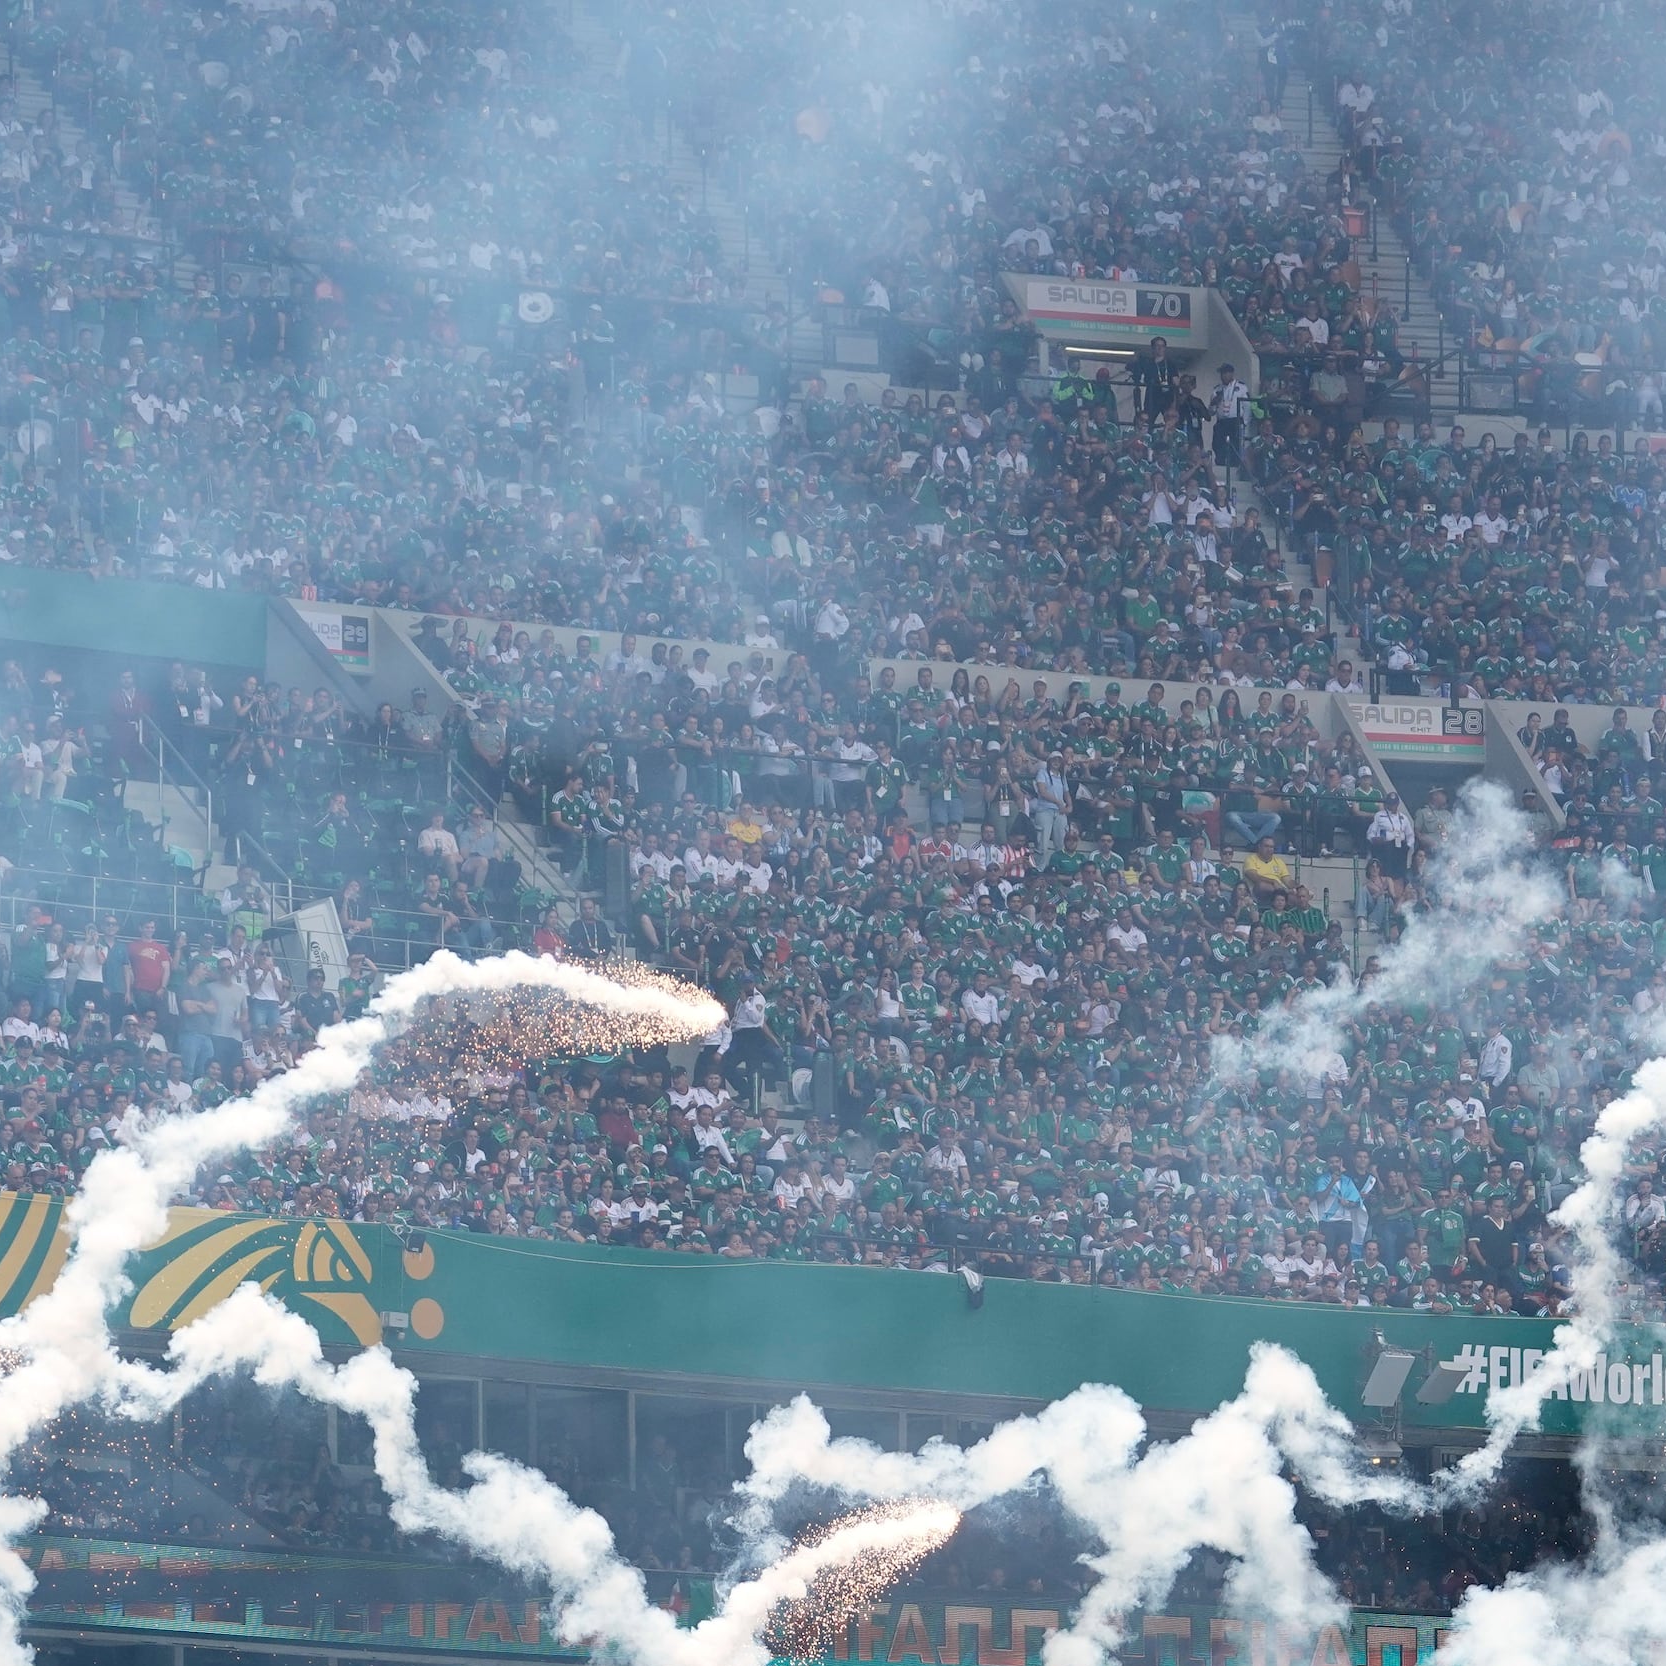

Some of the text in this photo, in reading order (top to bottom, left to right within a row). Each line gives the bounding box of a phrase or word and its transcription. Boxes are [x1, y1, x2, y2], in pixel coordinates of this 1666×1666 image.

[1048, 286, 1181, 317] SALIDA 70
[343, 624, 367, 643] 29
[1351, 705, 1483, 735] SALIDA 28
[310, 941, 324, 971] Coron
[834, 1603, 935, 1664] IFA
